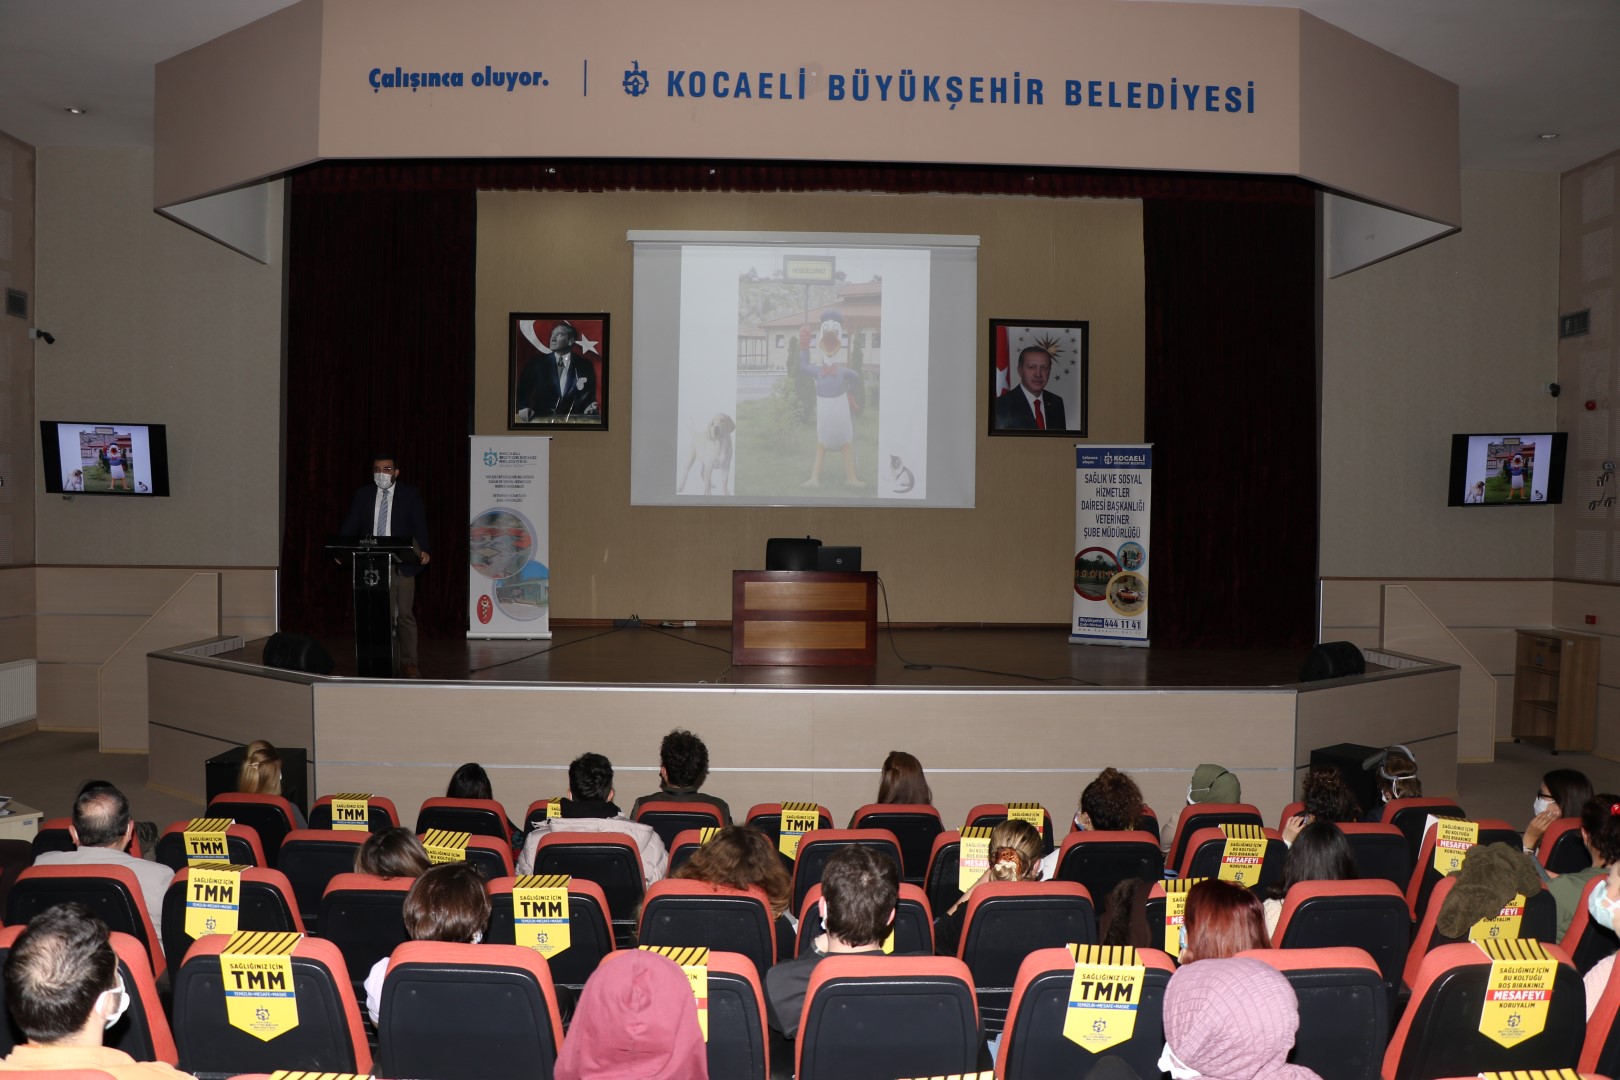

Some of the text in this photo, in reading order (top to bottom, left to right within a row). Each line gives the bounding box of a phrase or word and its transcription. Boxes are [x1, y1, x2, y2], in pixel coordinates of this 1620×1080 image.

[368, 65, 550, 93] Çalışınca oluyor.
[666, 67, 1255, 113] KOCAELİ BÜYÜKŞEHİR BELEDİYESİ
[1084, 472, 1142, 484] SAĞLIK VE SOSYAL
[1096, 485, 1130, 497] HİZMETLER
[1082, 499, 1145, 513] DAİRESİ BAŞKANLIĞI
[1096, 513, 1130, 524] VETERİNER
[1084, 526, 1140, 539] ŞUBE MÜDÜRLÜĞÜ
[1132, 621, 1140, 629] 41
[337, 809, 364, 820] TMM
[786, 820, 814, 831] TMM
[191, 842, 224, 854] TMM
[194, 884, 233, 903] TMM
[520, 902, 562, 917] TMM
[231, 971, 286, 990] TMM
[1081, 981, 1133, 1002] TMM
[1494, 990, 1545, 1000] MESAFEYİ
